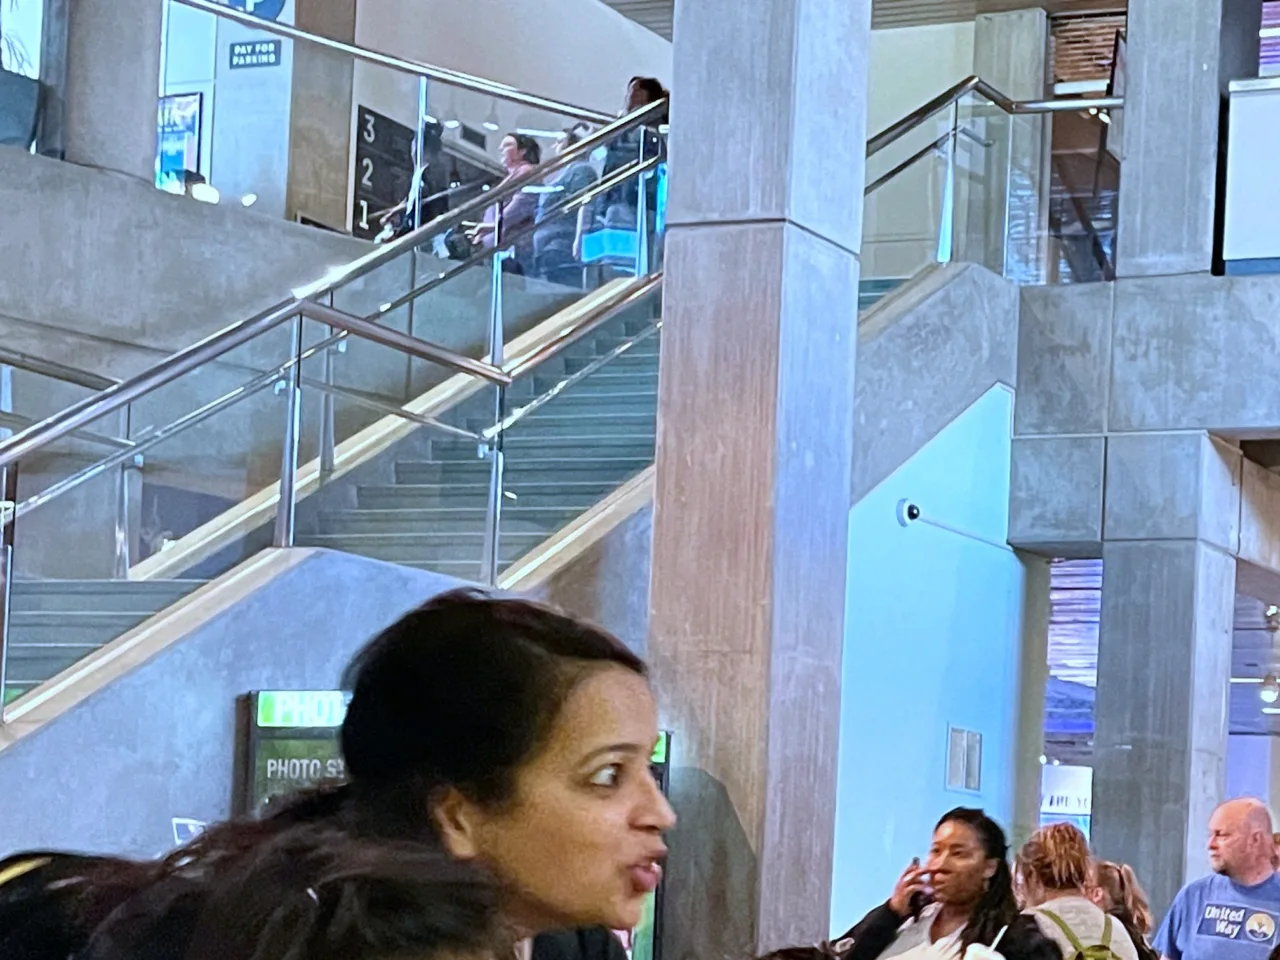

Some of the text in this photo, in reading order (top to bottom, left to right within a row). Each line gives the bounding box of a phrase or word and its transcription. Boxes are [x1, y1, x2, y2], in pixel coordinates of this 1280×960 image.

[232, 53, 276, 65] PARKING
[233, 42, 275, 55] PAY FOR
[363, 113, 375, 143] 3
[361, 157, 374, 187] 2
[359, 199, 369, 230] 1
[267, 758, 321, 780] PHOTO
[1204, 905, 1246, 922] United
[1215, 919, 1241, 939] Way
